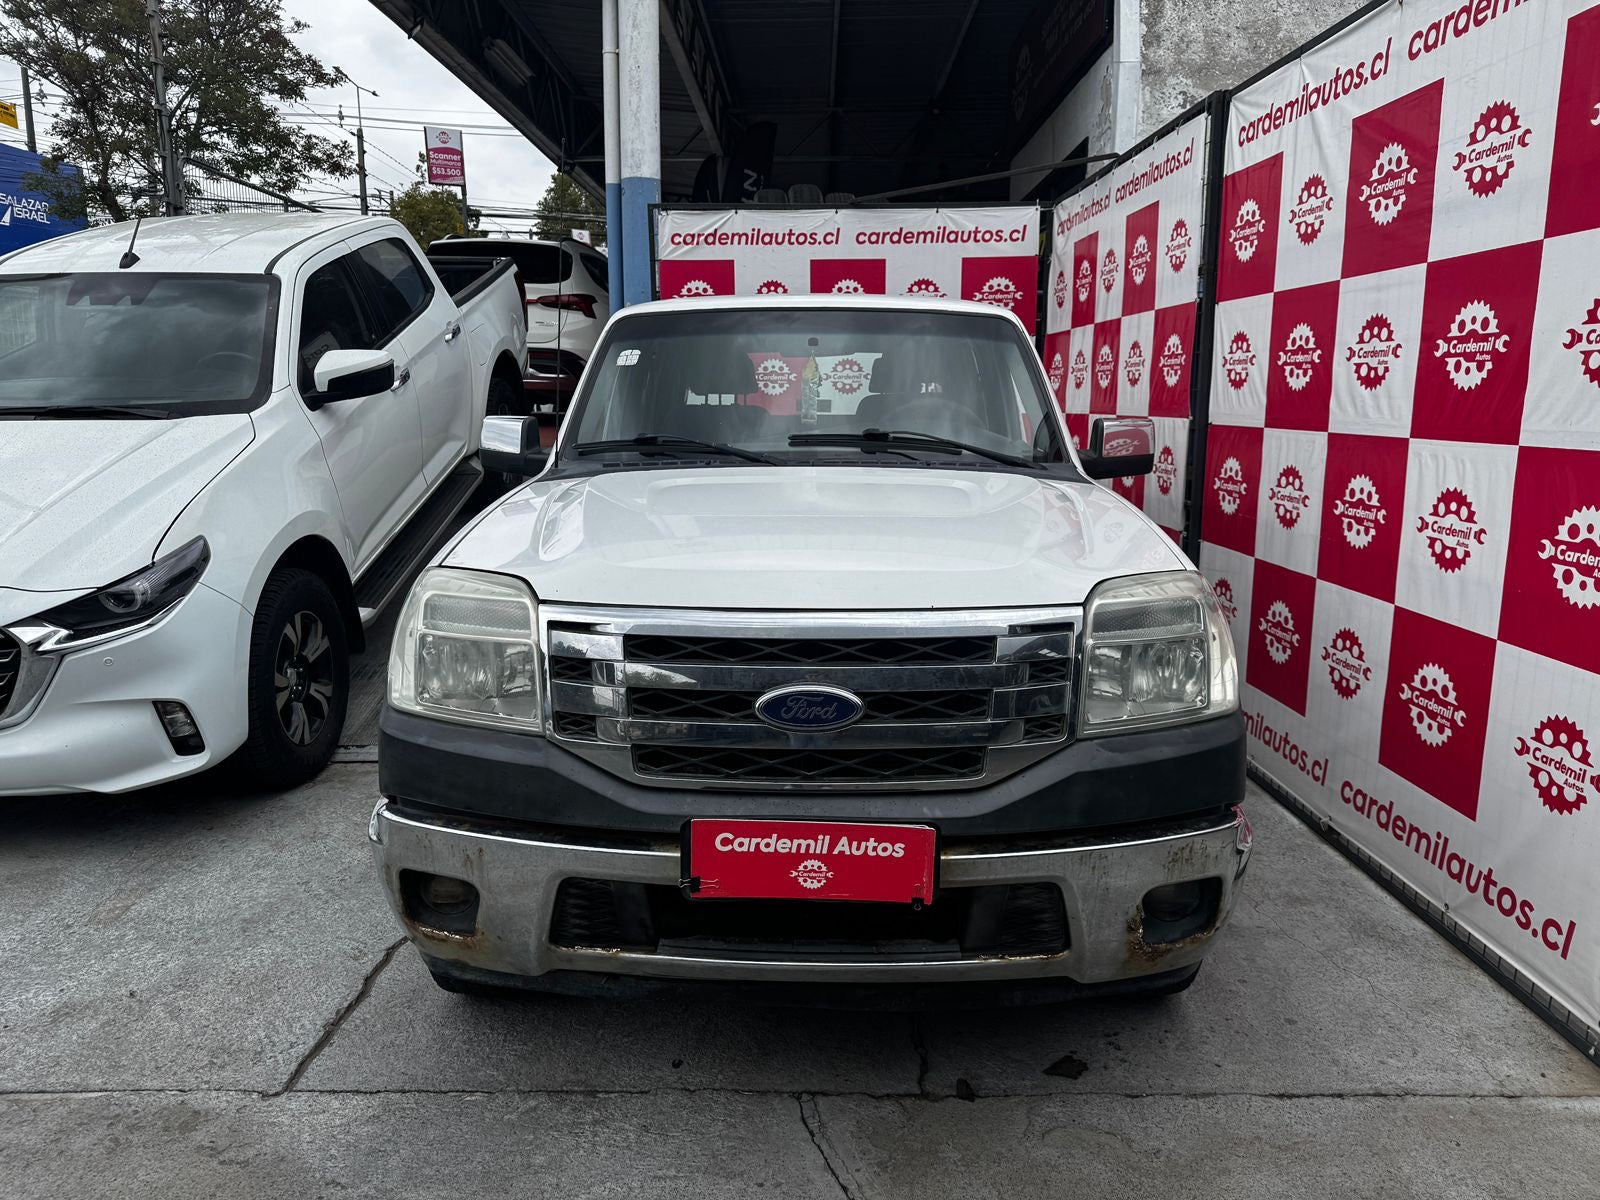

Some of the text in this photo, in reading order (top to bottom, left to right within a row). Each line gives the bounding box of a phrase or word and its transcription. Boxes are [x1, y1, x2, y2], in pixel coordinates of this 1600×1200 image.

[1238, 37, 1392, 147] cardemilautos.cl
[429, 151, 461, 161] Scanner
[1468, 134, 1515, 164] Cardemil
[1496, 152, 1513, 164] Autos
[432, 167, 461, 176] $53.500
[1115, 137, 1194, 204] cardemilautos.cl
[1371, 173, 1407, 196] Cardemil
[13, 207, 51, 224] ISRAEL
[1298, 202, 1325, 218] Cardemil
[670, 225, 1027, 247] cardemilautos.cl cardemilautos.cl
[1236, 222, 1258, 239] Cardemil
[983, 292, 1014, 300] Cardemil
[1357, 345, 1390, 359] Cardemil
[1449, 337, 1494, 353] Cardemil
[1287, 351, 1312, 362] Cardemil
[1475, 352, 1491, 361] Autos
[759, 373, 788, 381] Cardemil
[832, 373, 862, 381] Cardemil
[1277, 491, 1302, 504] Cardemil
[1343, 503, 1377, 520] Cardemil
[1430, 520, 1472, 541] Cardemil
[1455, 539, 1469, 549] Autos
[1267, 622, 1292, 641] Cardemil
[1331, 653, 1362, 675] Cardemil
[781, 694, 837, 720] Ford
[1412, 691, 1453, 721] Cardemil
[1436, 715, 1451, 727] Autos
[1532, 747, 1587, 784] Cardemil
[1562, 778, 1584, 793] Autos
[715, 832, 905, 857] Cardemil Autos
[1340, 780, 1576, 960] cardemilautos.cl
